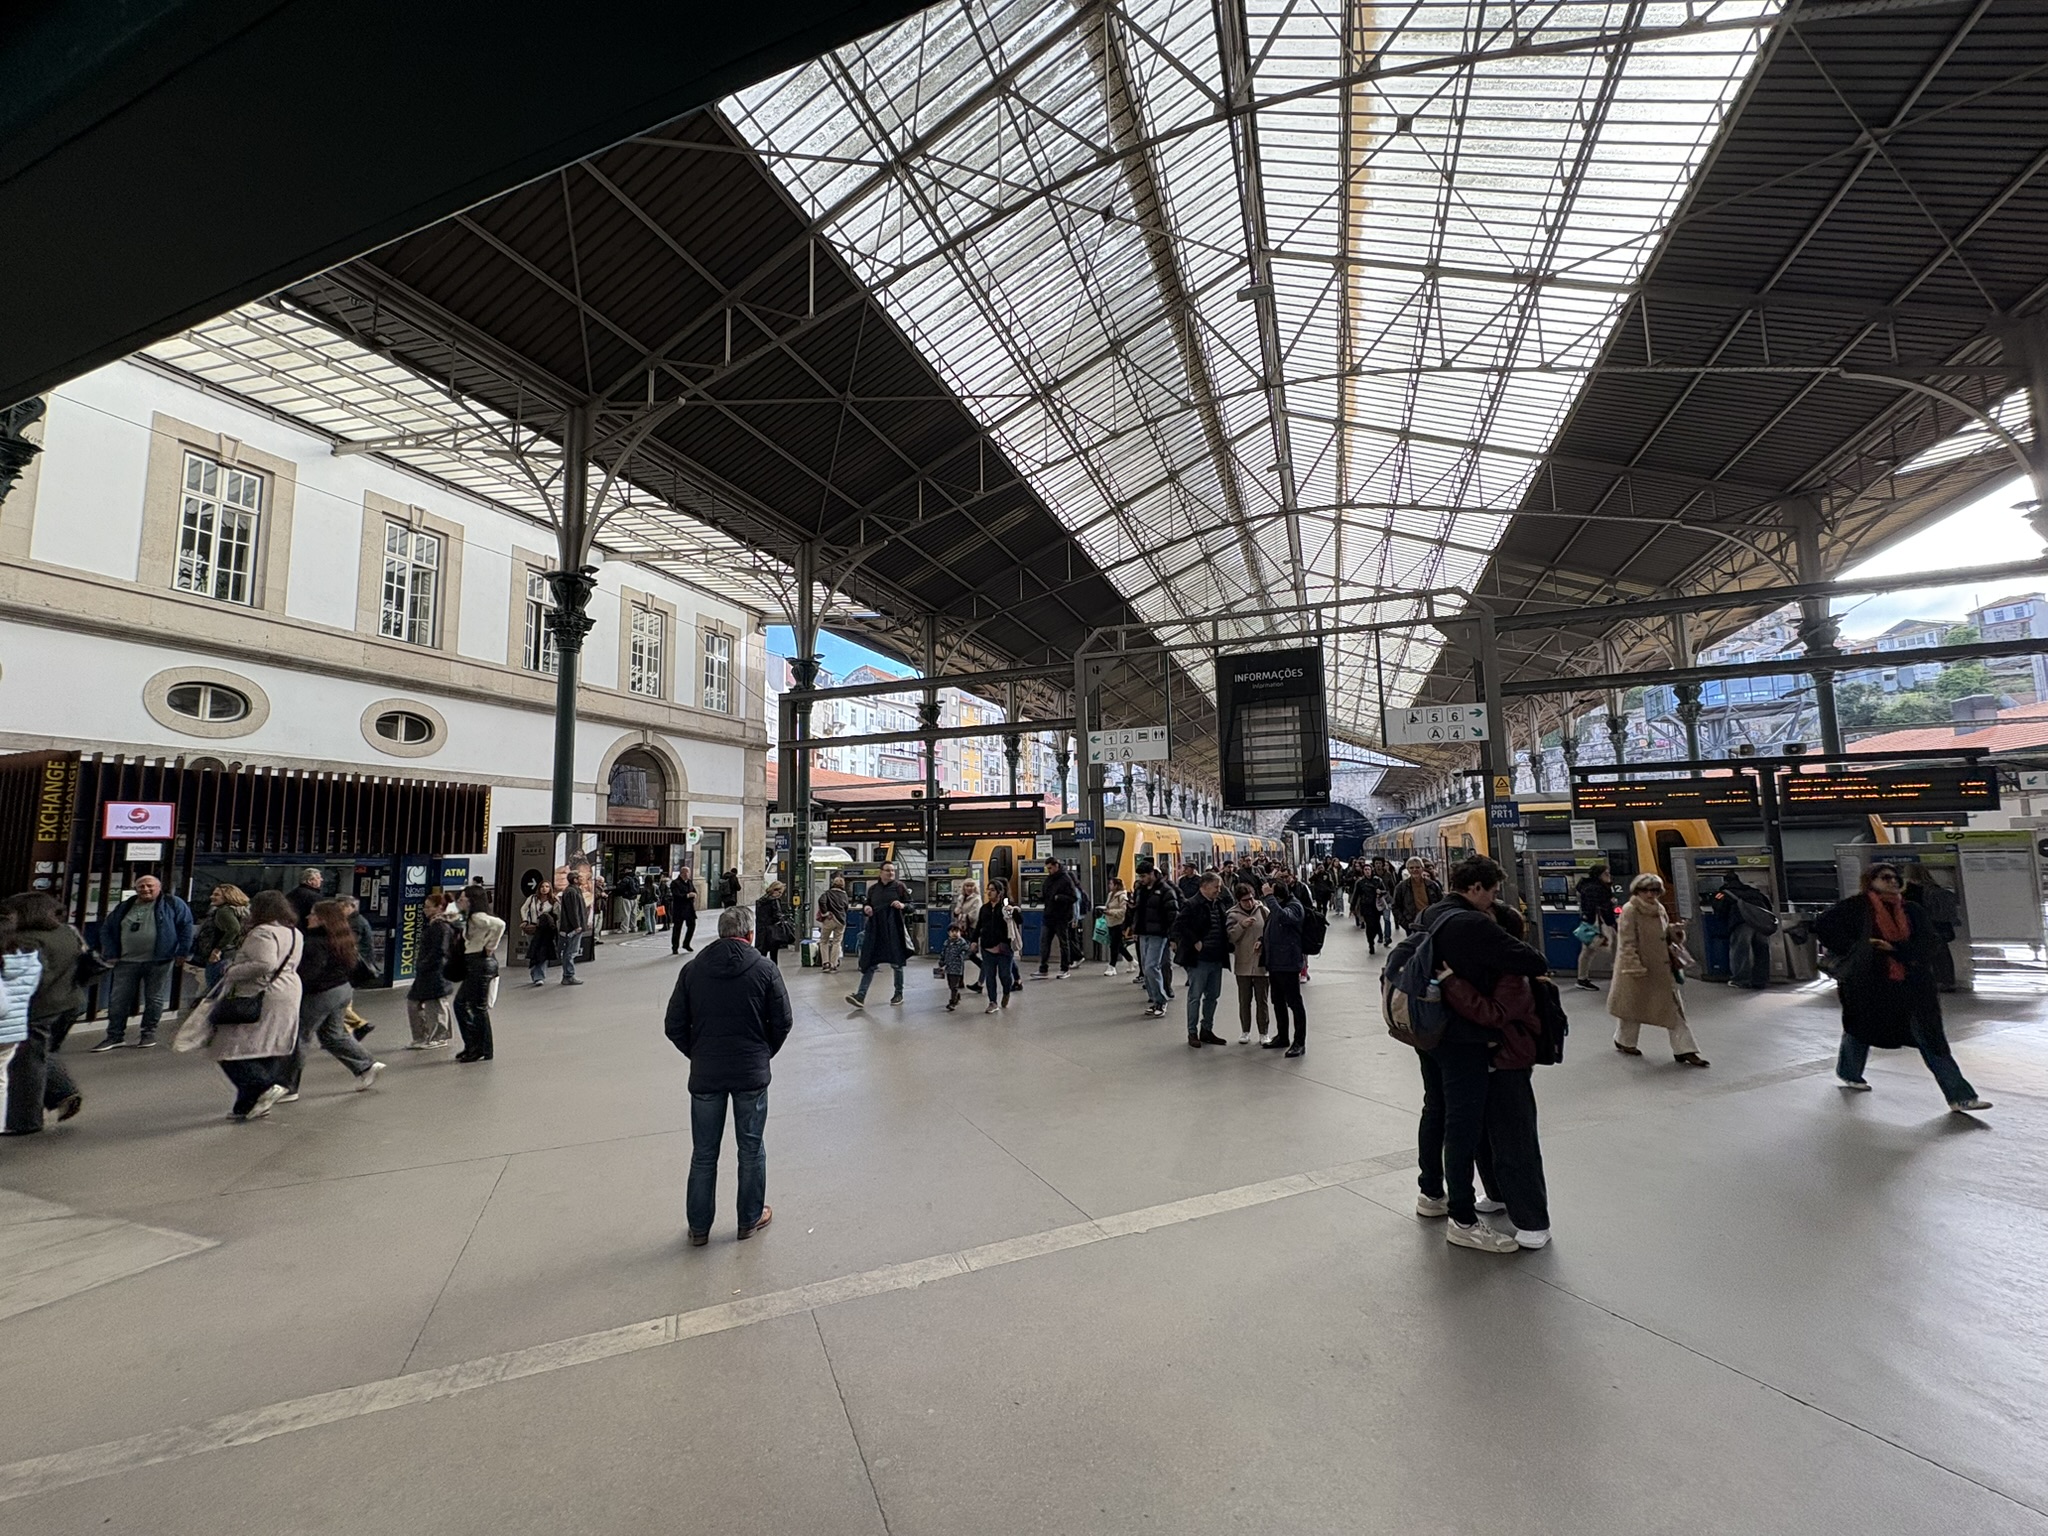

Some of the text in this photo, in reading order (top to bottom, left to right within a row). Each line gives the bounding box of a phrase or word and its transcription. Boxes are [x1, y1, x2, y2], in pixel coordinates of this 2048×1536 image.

[1234, 668, 1303, 683] INFORMAÇÕES
[1431, 712, 1458, 722] 5 6
[1123, 735, 1130, 743] 2
[1431, 730, 1460, 739] A 4
[38, 760, 66, 841] EXCHANGE
[61, 761, 78, 841] EXCHANGE
[1491, 810, 1513, 818] PRT1
[444, 868, 466, 877] ATM
[400, 904, 416, 975] EXCHANGE
